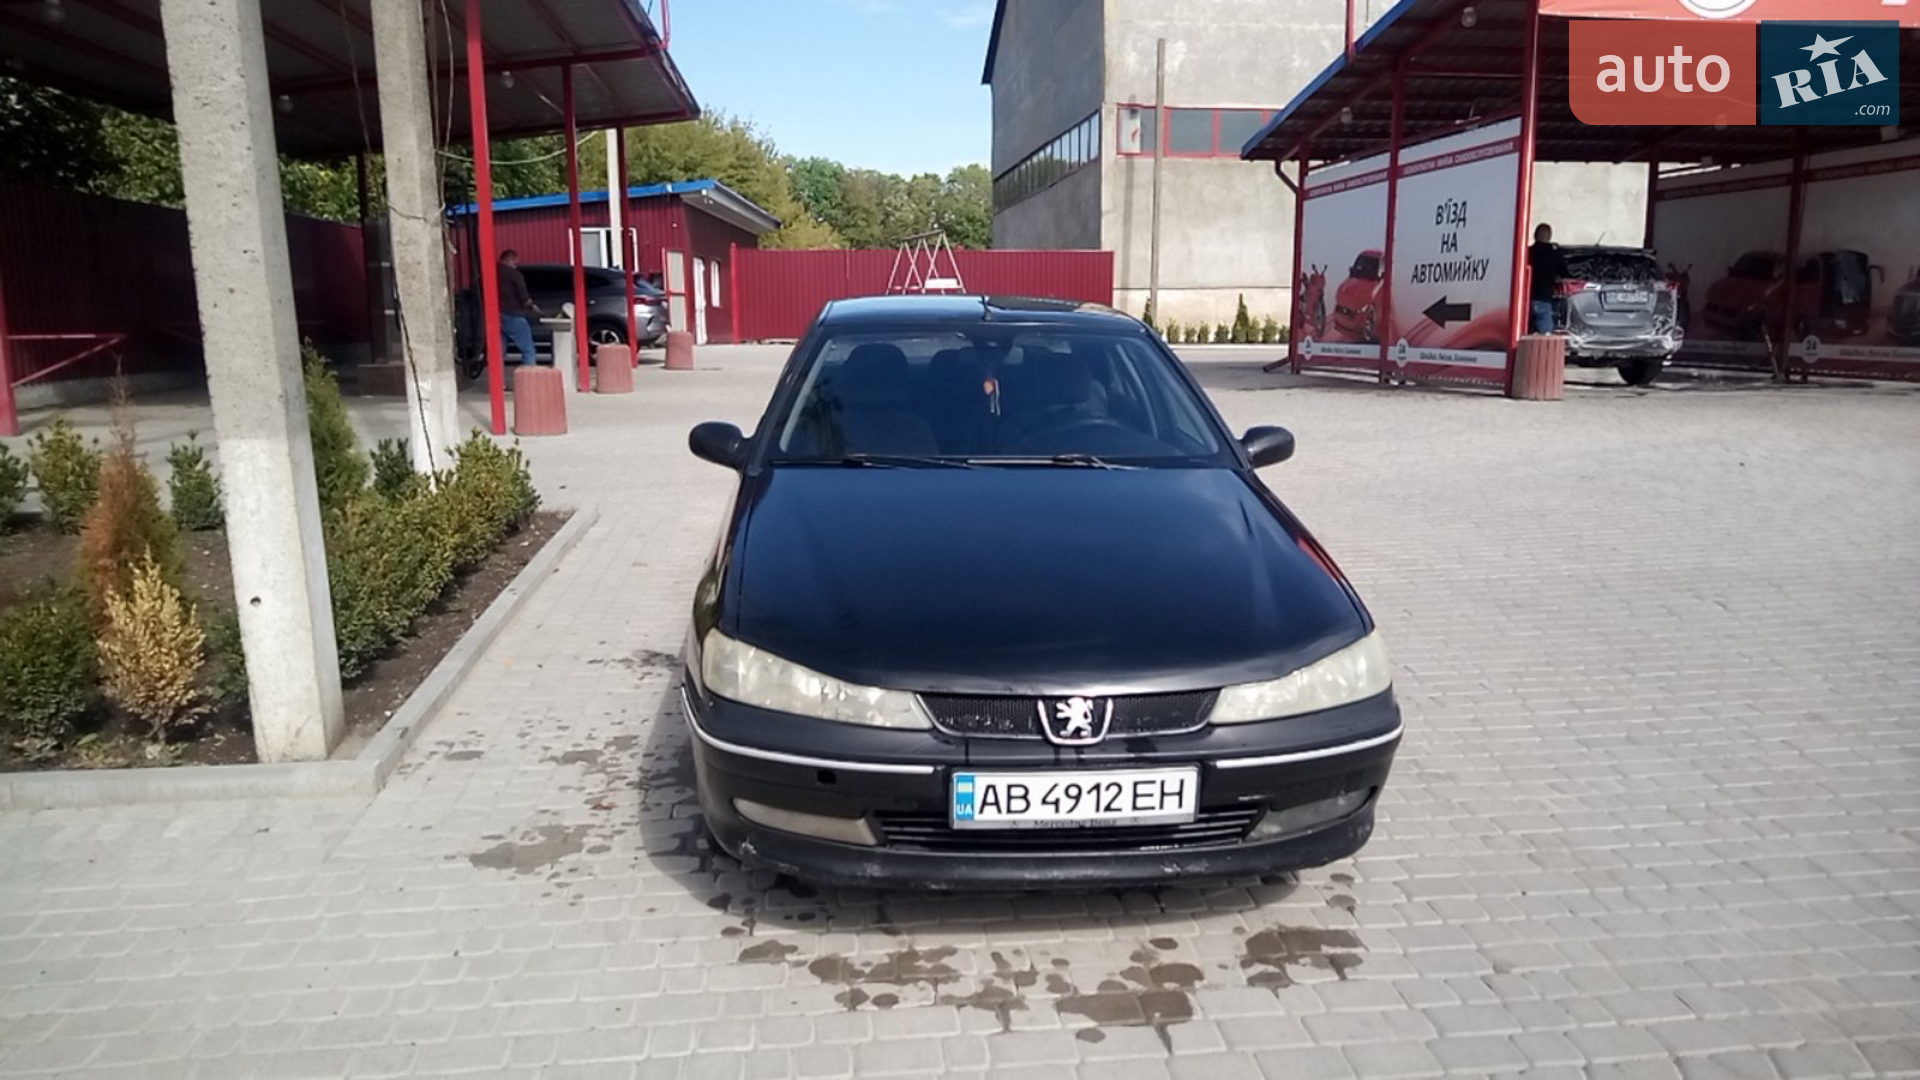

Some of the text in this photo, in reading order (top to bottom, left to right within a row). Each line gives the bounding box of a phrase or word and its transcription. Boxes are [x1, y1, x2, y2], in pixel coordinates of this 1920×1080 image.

[1435, 198, 1467, 229] В'ЇЗД
[1441, 232, 1458, 253] НА
[1410, 254, 1490, 284] АВТОМИЙКУ
[956, 803, 974, 815] UA
[978, 778, 1185, 815] AB 4912 EH
